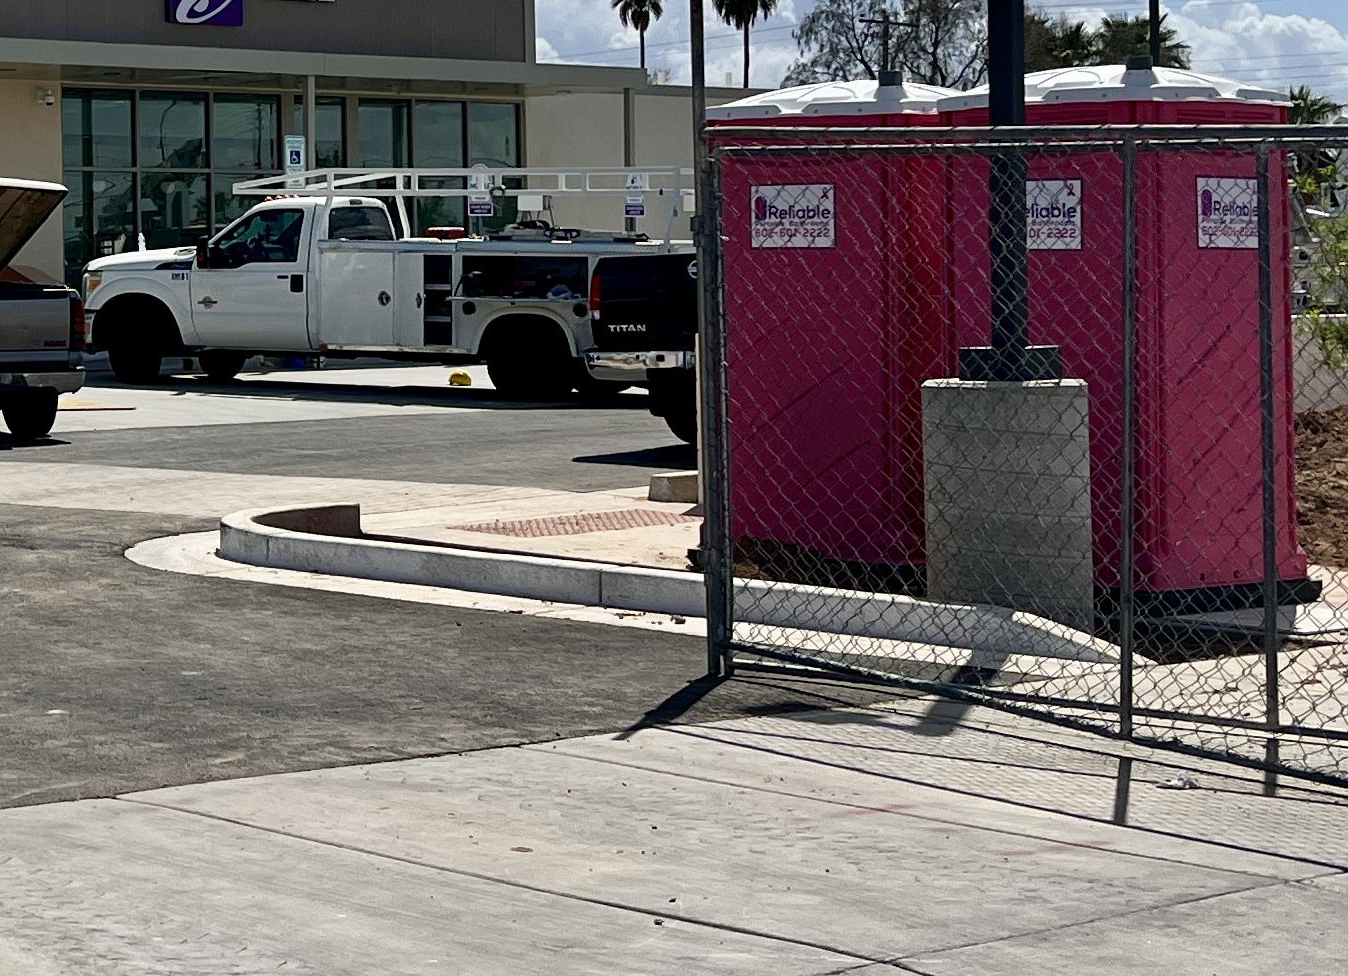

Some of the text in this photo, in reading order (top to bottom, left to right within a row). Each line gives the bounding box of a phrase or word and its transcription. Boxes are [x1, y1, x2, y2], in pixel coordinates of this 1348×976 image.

[767, 204, 831, 220] Reliable
[1026, 203, 1077, 219] liable
[754, 227, 831, 238] 602-601-2222
[1028, 227, 1077, 239] 01-2222
[607, 324, 647, 333] TITAN
